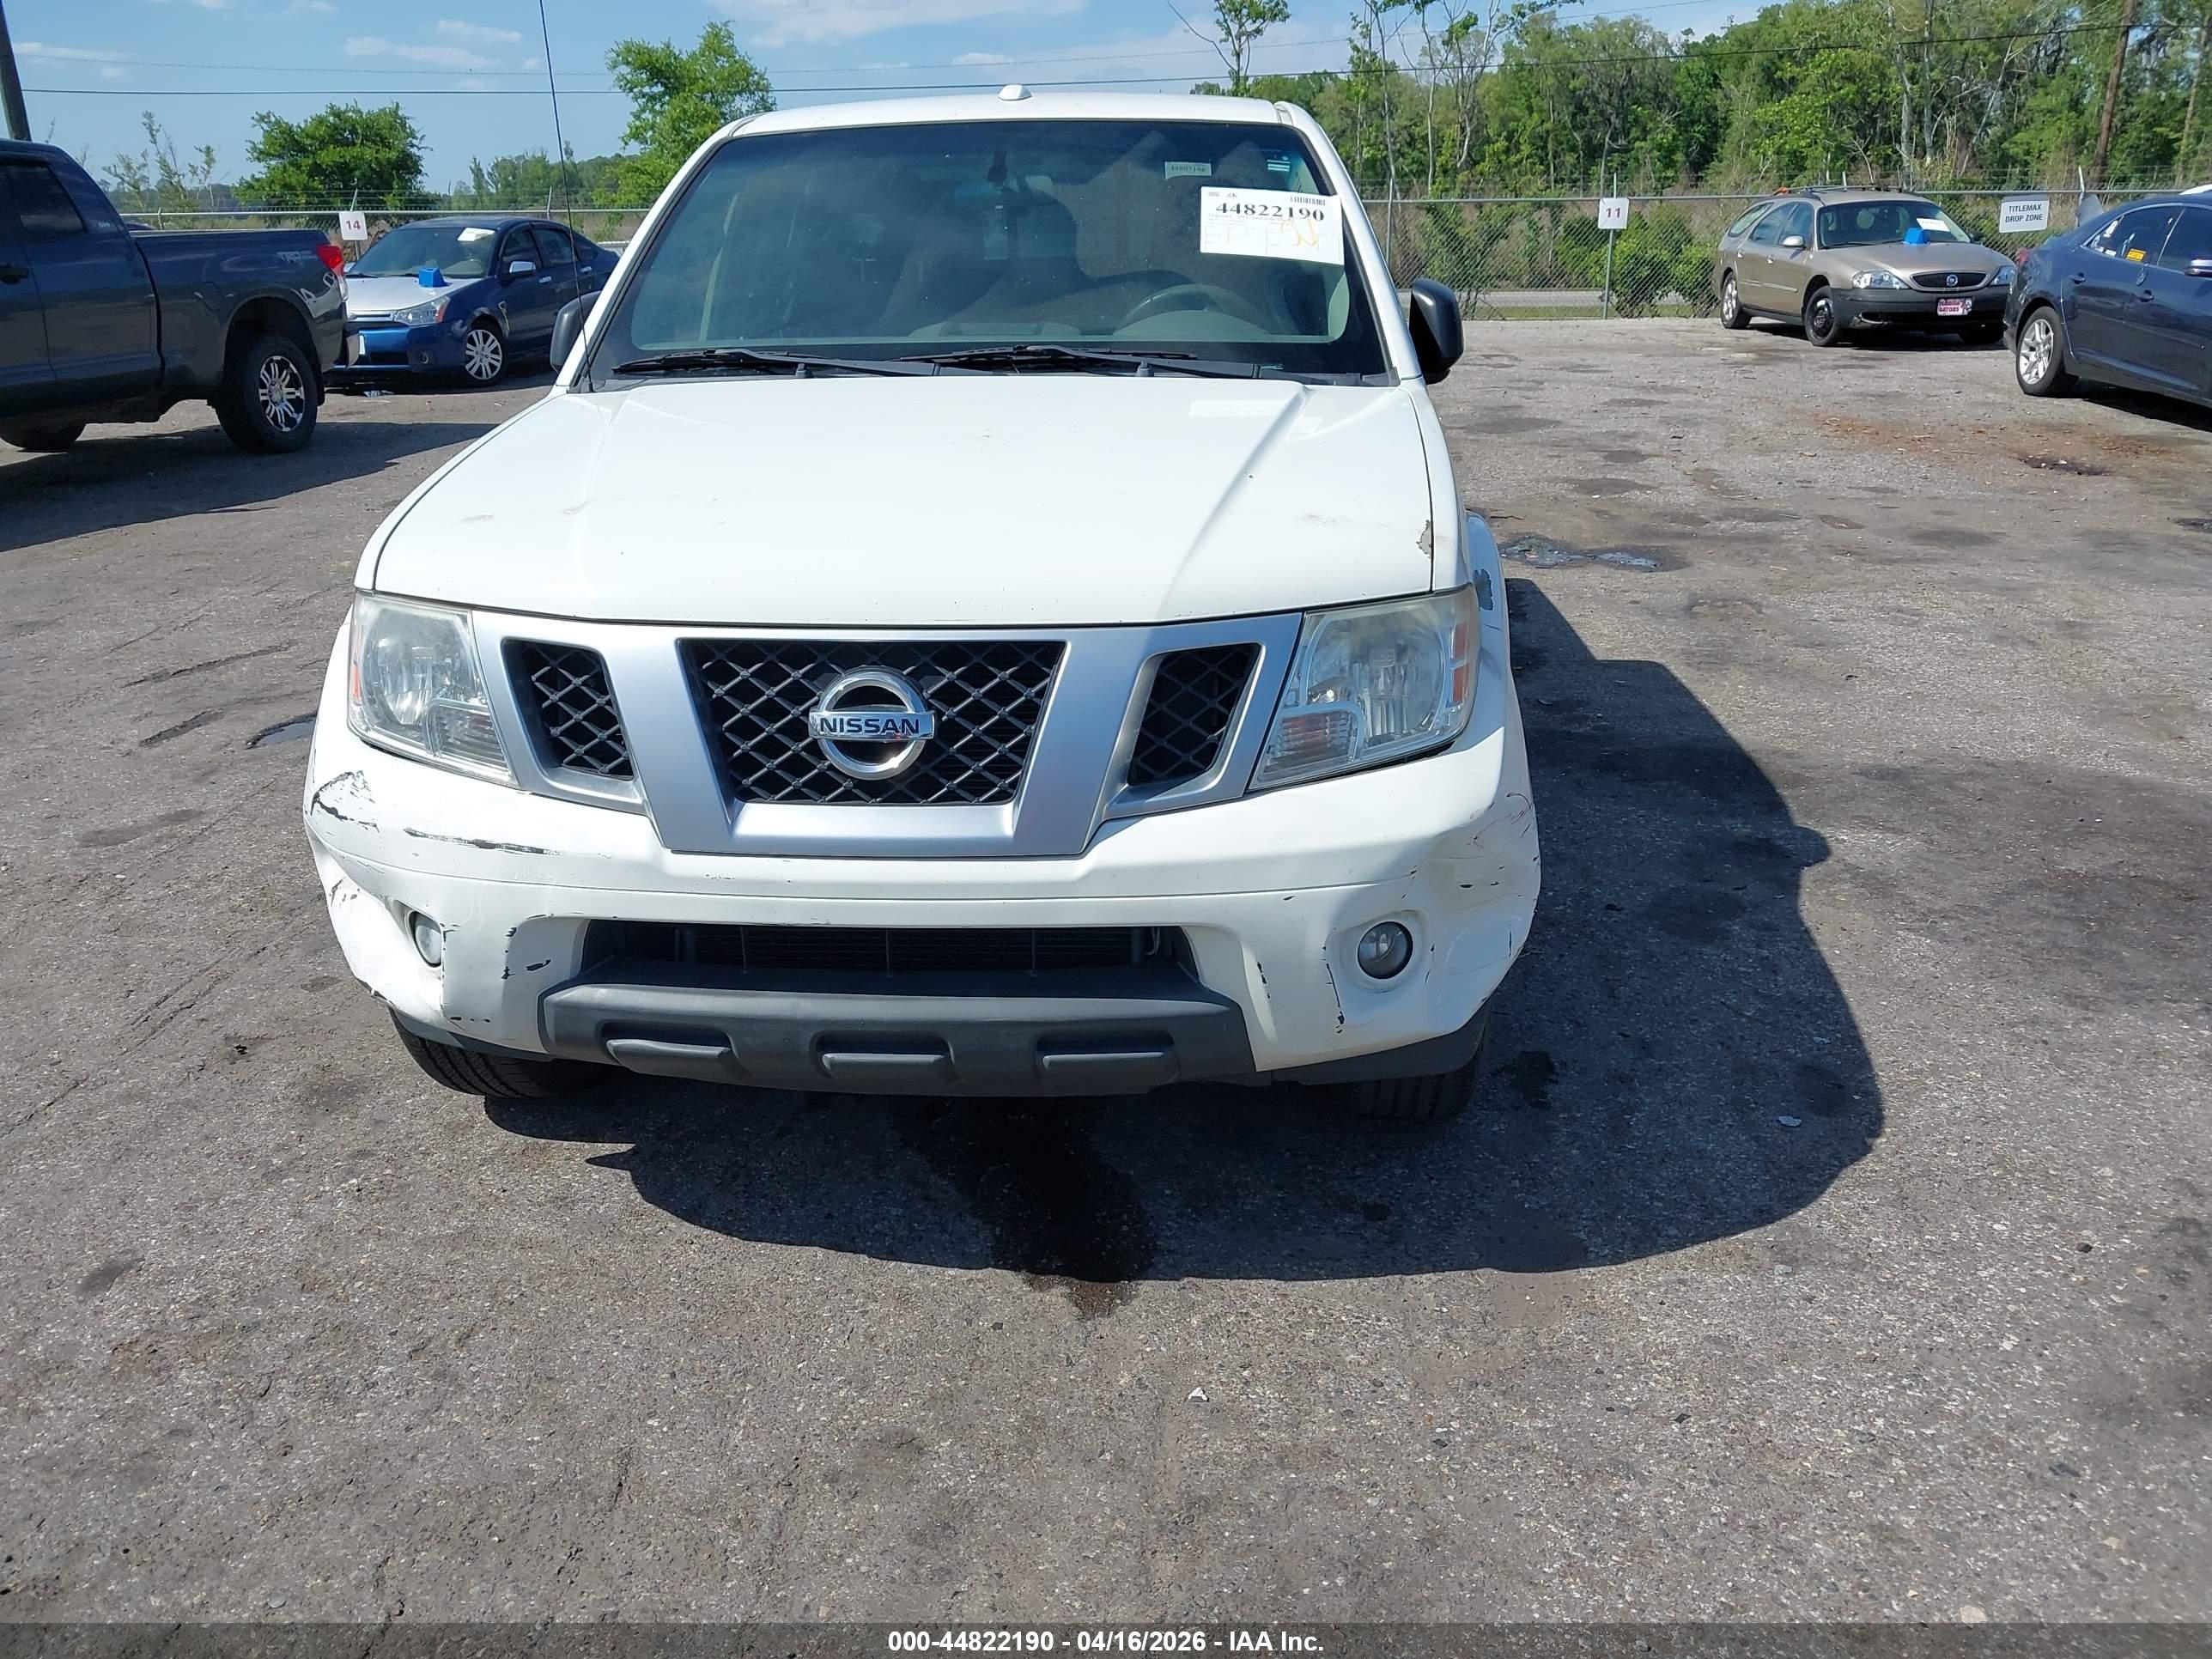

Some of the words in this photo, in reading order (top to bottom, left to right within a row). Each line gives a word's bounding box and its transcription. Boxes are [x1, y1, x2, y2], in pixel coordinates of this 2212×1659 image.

[1216, 202, 1325, 222] 44822190
[1606, 207, 1620, 218] 11
[2008, 204, 2042, 212] TITLEMAX
[2005, 215, 2024, 223] DROP
[346, 220, 361, 230] 14
[820, 717, 920, 734] NISSAN
